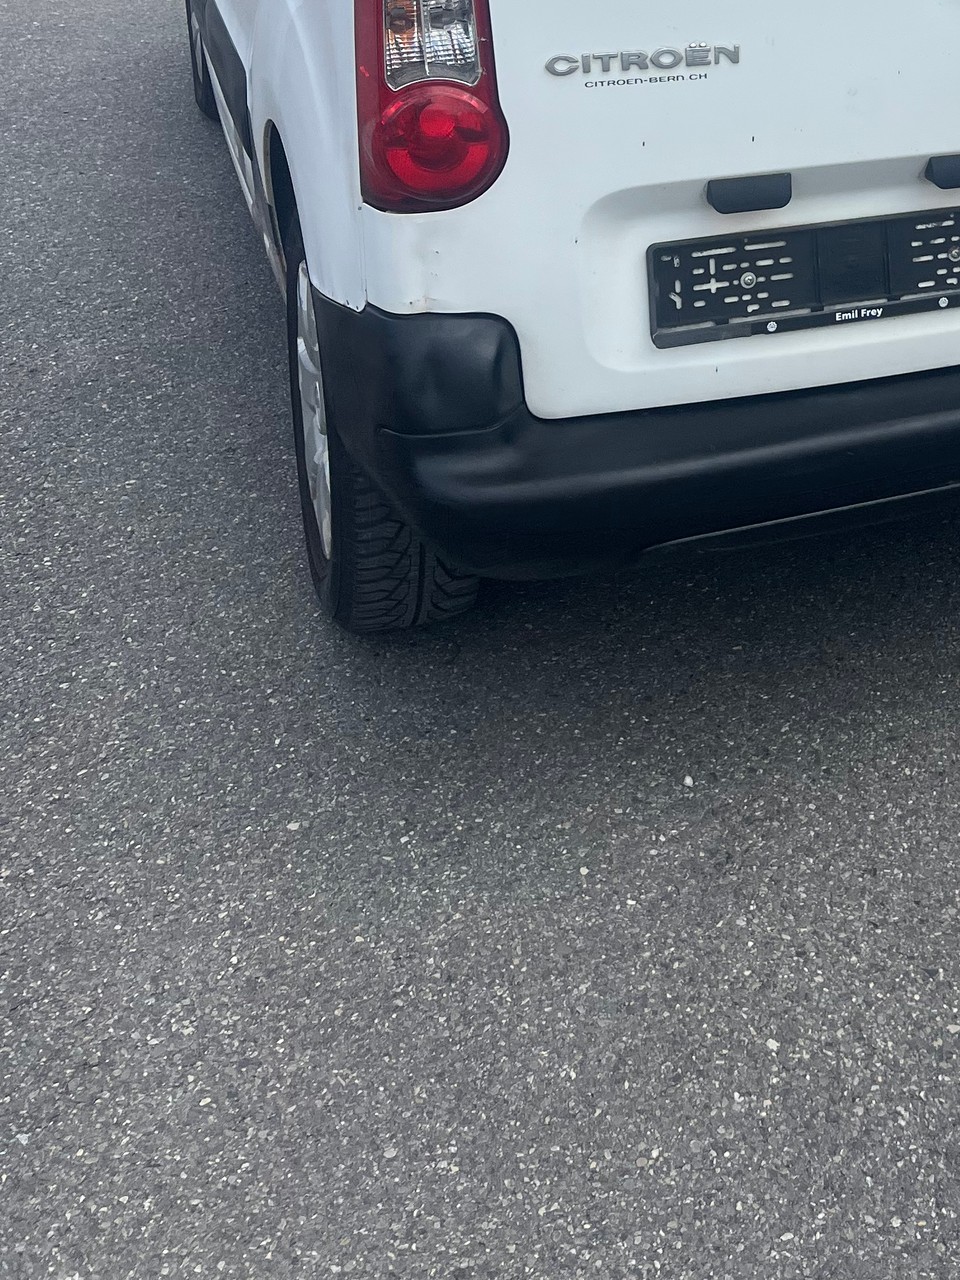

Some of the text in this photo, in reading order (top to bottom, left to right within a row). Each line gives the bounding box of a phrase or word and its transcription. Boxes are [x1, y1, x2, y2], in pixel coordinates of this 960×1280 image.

[545, 42, 740, 76] CITROËN
[835, 308, 883, 321] Emil Frey
